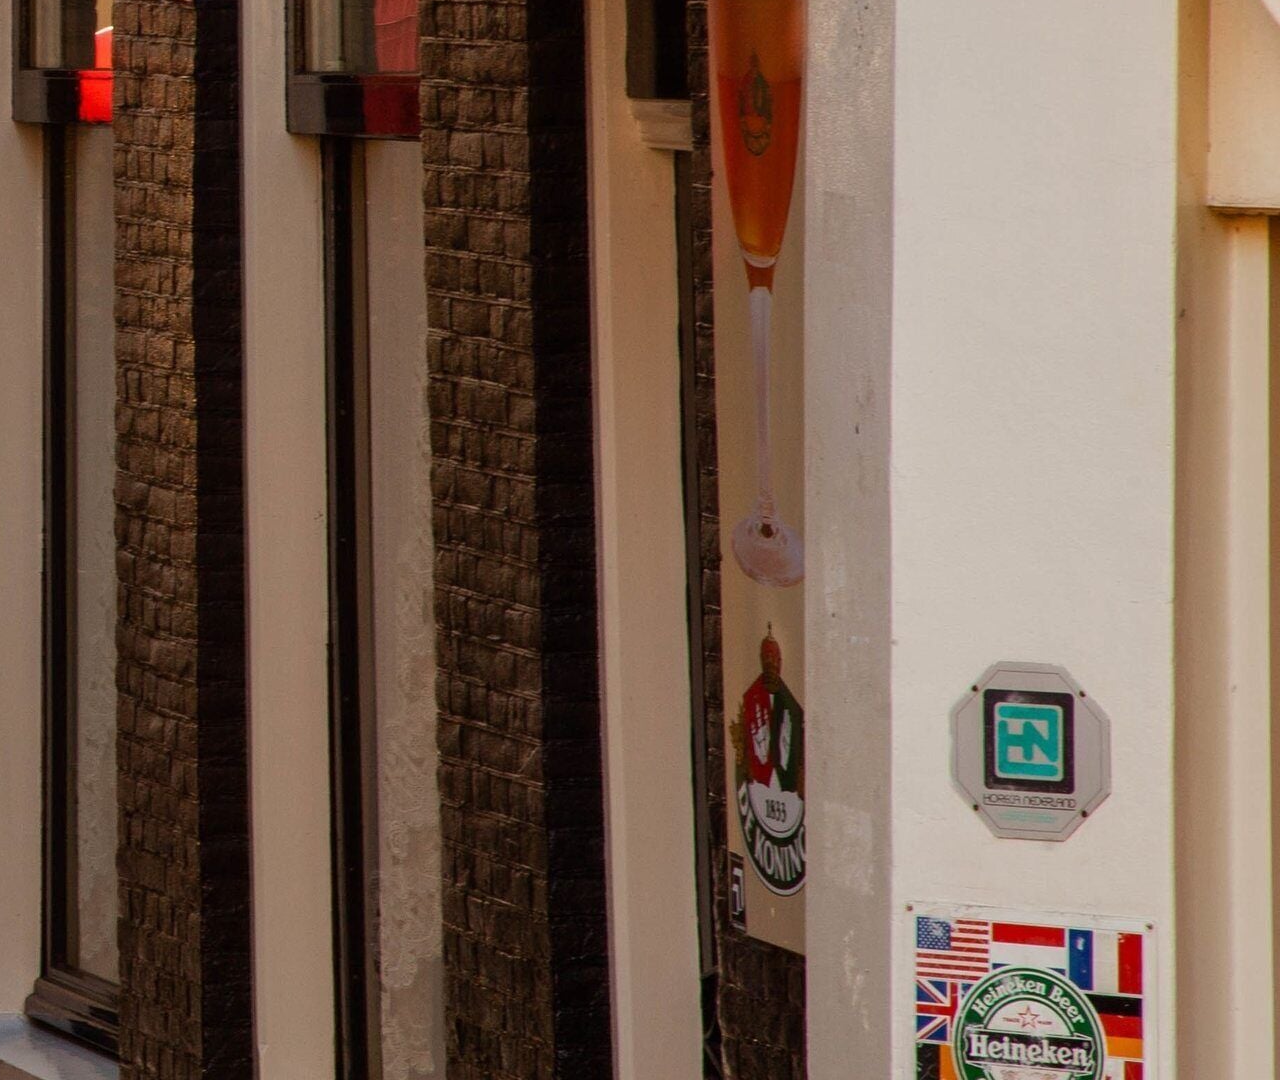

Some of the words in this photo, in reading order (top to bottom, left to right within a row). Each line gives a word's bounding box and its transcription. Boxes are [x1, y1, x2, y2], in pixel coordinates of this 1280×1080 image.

[1023, 796, 1077, 809] NEDERLAND
[971, 975, 1047, 1018] Heineken
[1048, 980, 1085, 1024] Beer
[969, 1033, 1092, 1068] Heineken
